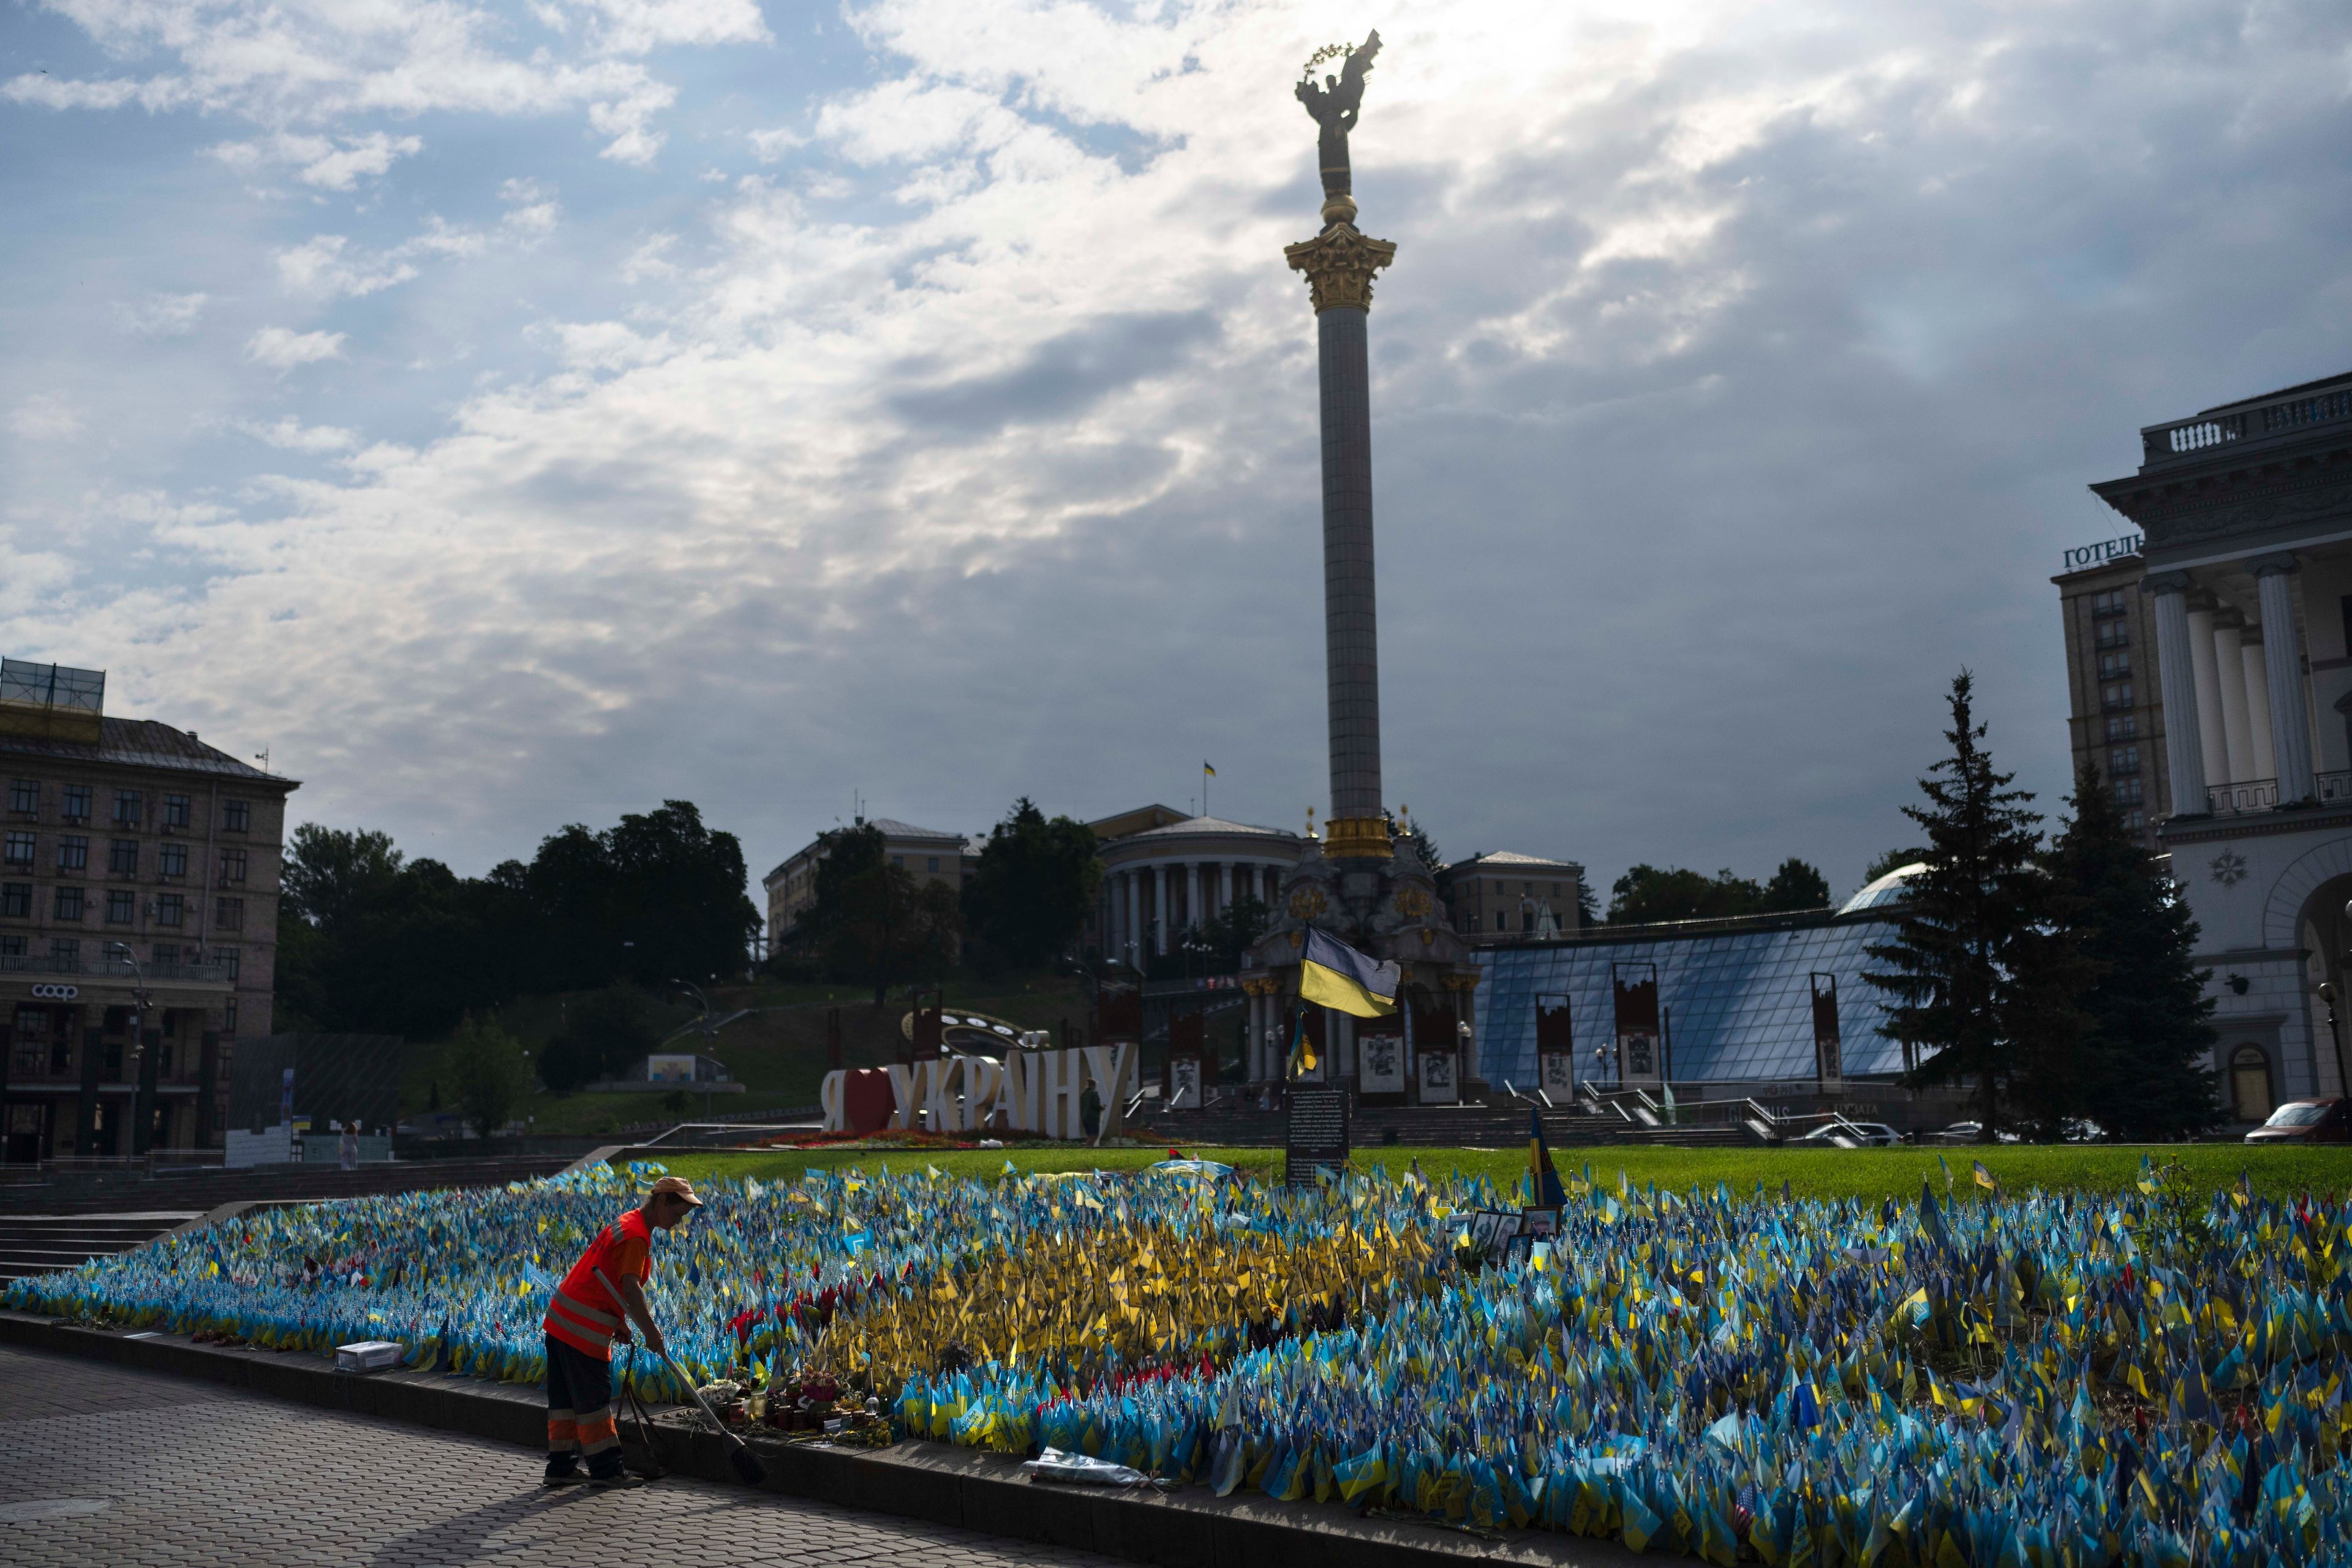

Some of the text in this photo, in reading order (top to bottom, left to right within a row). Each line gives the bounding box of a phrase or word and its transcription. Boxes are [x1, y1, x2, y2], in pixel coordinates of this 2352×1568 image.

[2063, 534, 2146, 568] ГОТЕЛЬ
[821, 1031, 1139, 1146] Я УКРАЇНУ
